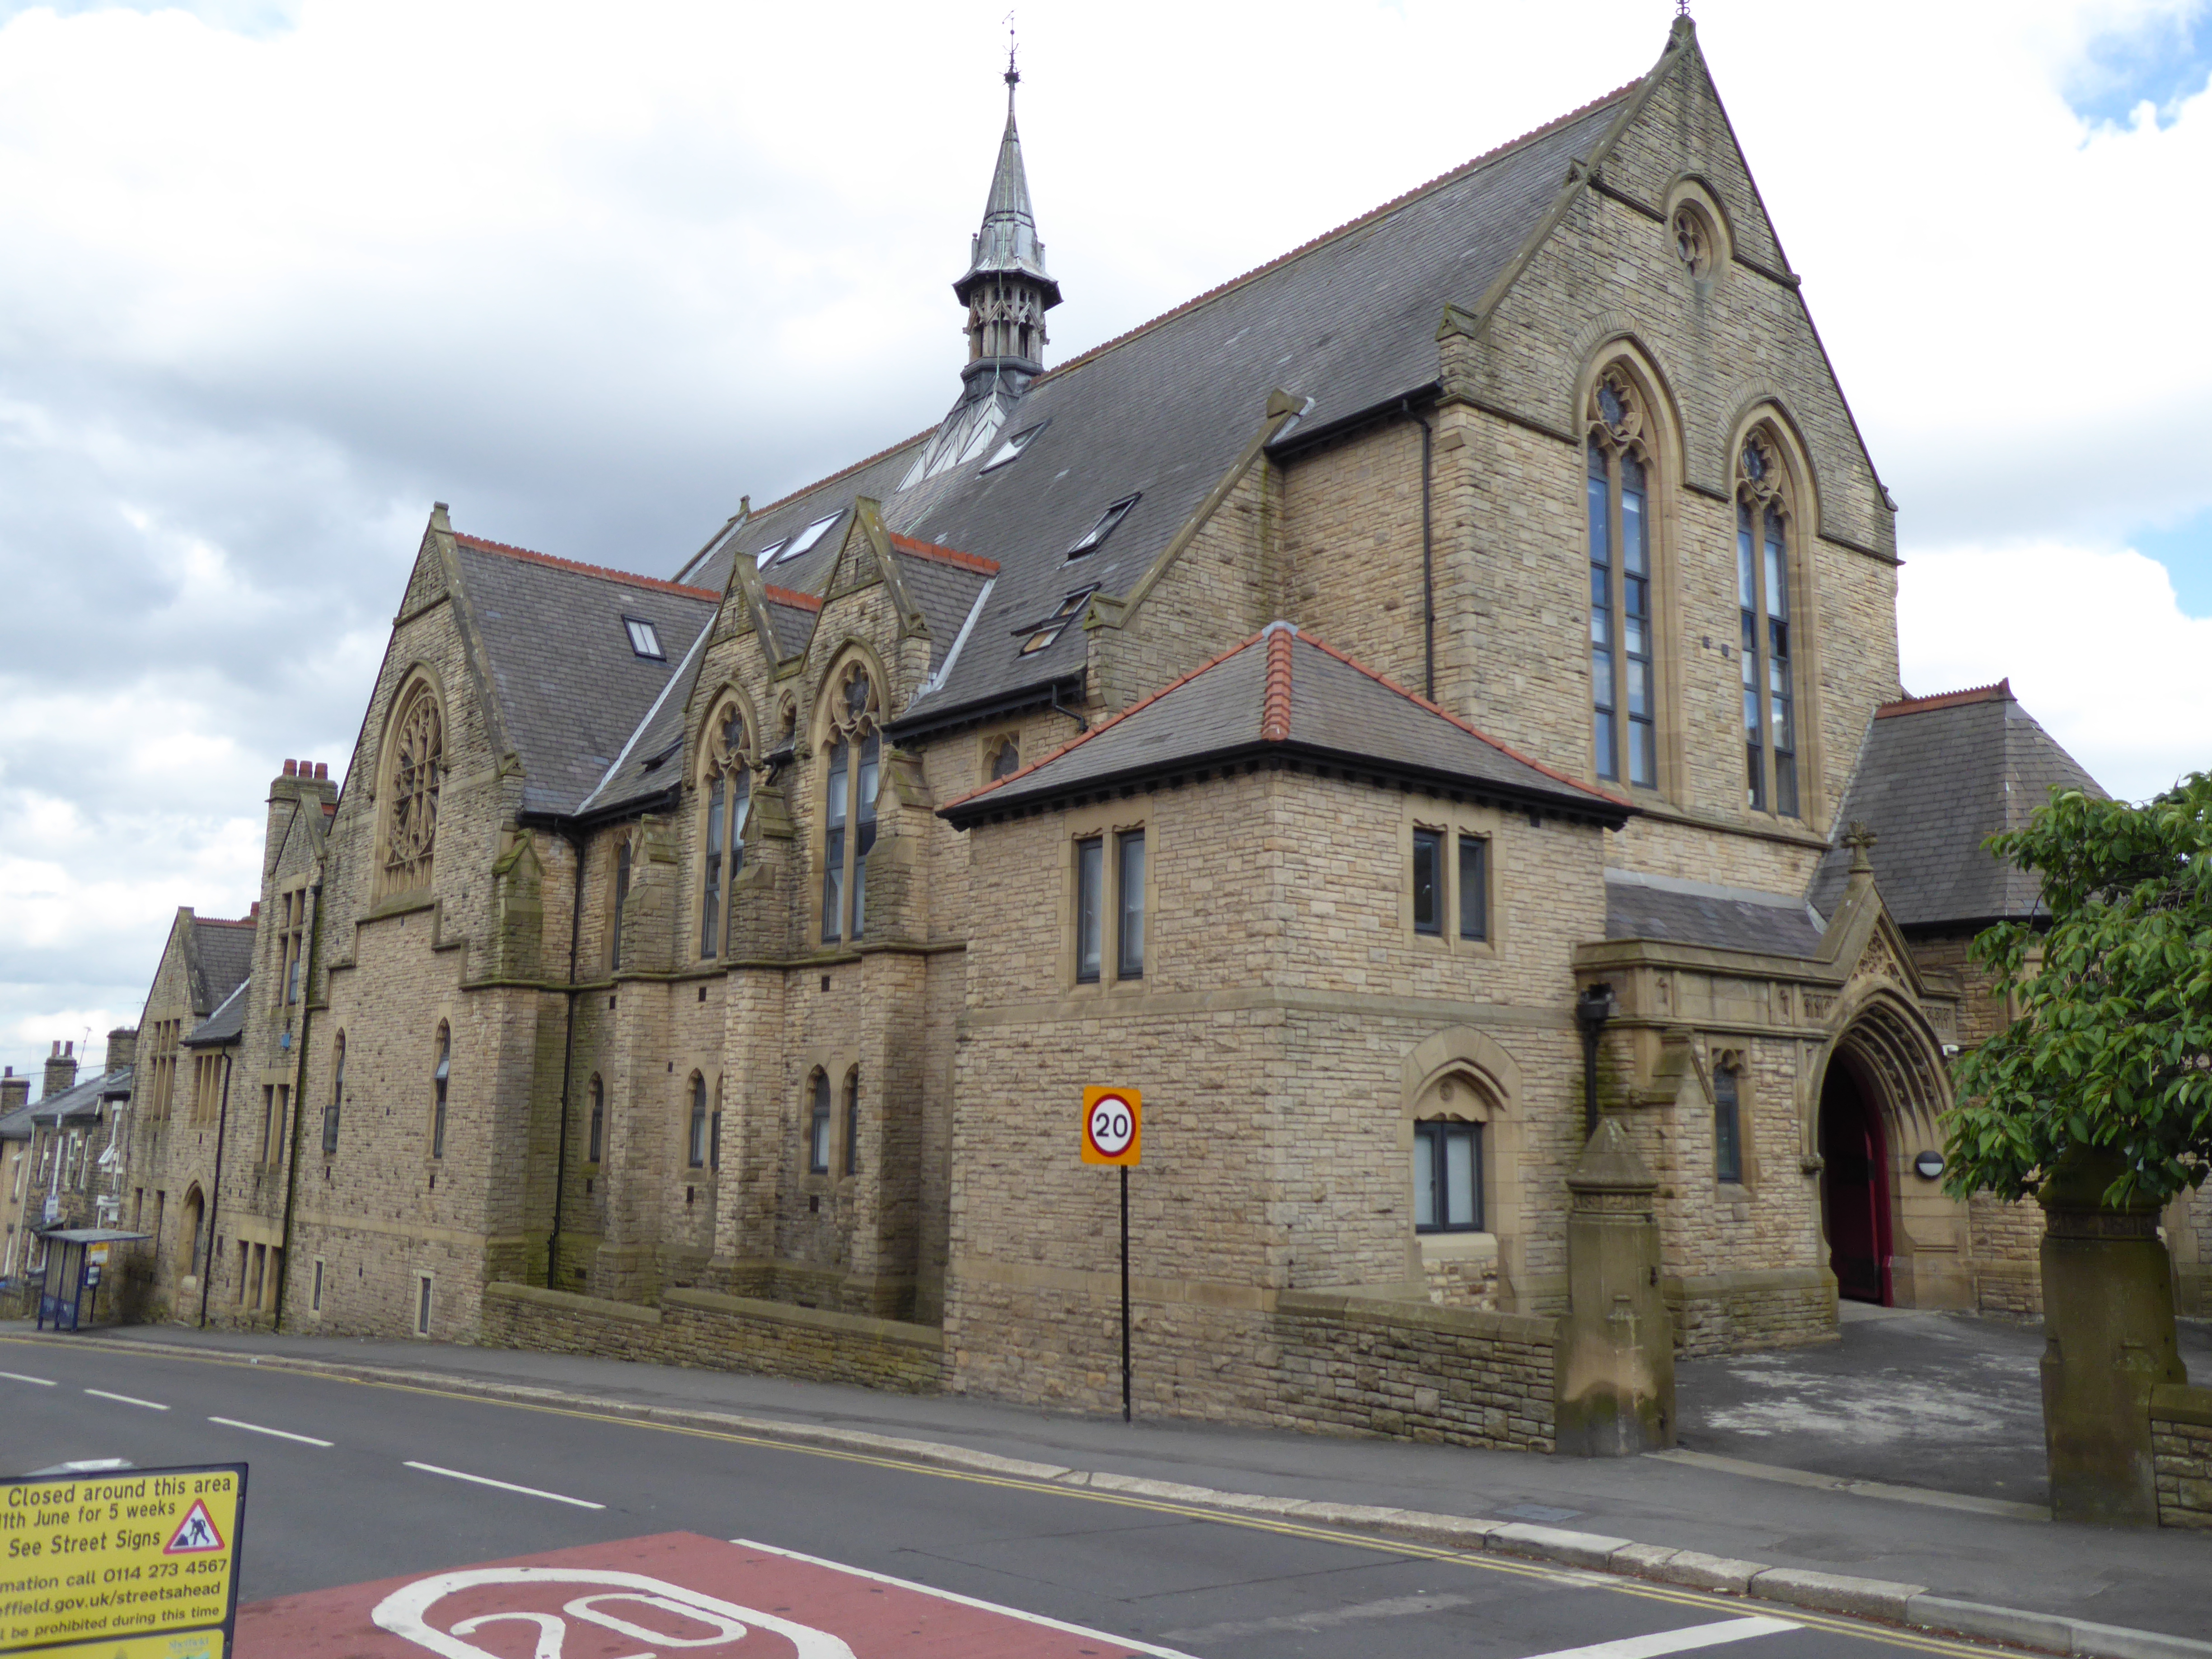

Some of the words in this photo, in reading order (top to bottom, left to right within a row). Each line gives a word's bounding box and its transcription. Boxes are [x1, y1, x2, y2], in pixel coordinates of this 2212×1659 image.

[1096, 1112, 1128, 1138] 20
[8, 1484, 75, 1508] Closed
[84, 1479, 145, 1501] around
[155, 1477, 185, 1496] this
[194, 1478, 230, 1493] area
[33, 1509, 70, 1527] June
[78, 1505, 102, 1523] for
[109, 1502, 118, 1520] 5
[127, 1499, 175, 1518] weeks
[8, 1538, 42, 1557] See
[51, 1532, 107, 1554] Street
[116, 1529, 160, 1551] Signs
[66, 1570, 95, 1587] call
[103, 1566, 141, 1583] 0114
[148, 1562, 178, 1578] 273
[185, 1558, 227, 1575] 4567
[11, 1626, 28, 1639] be
[34, 1616, 107, 1638] prohibited
[112, 1613, 155, 1626] during
[162, 1608, 185, 1622] this
[191, 1606, 219, 1618] time
